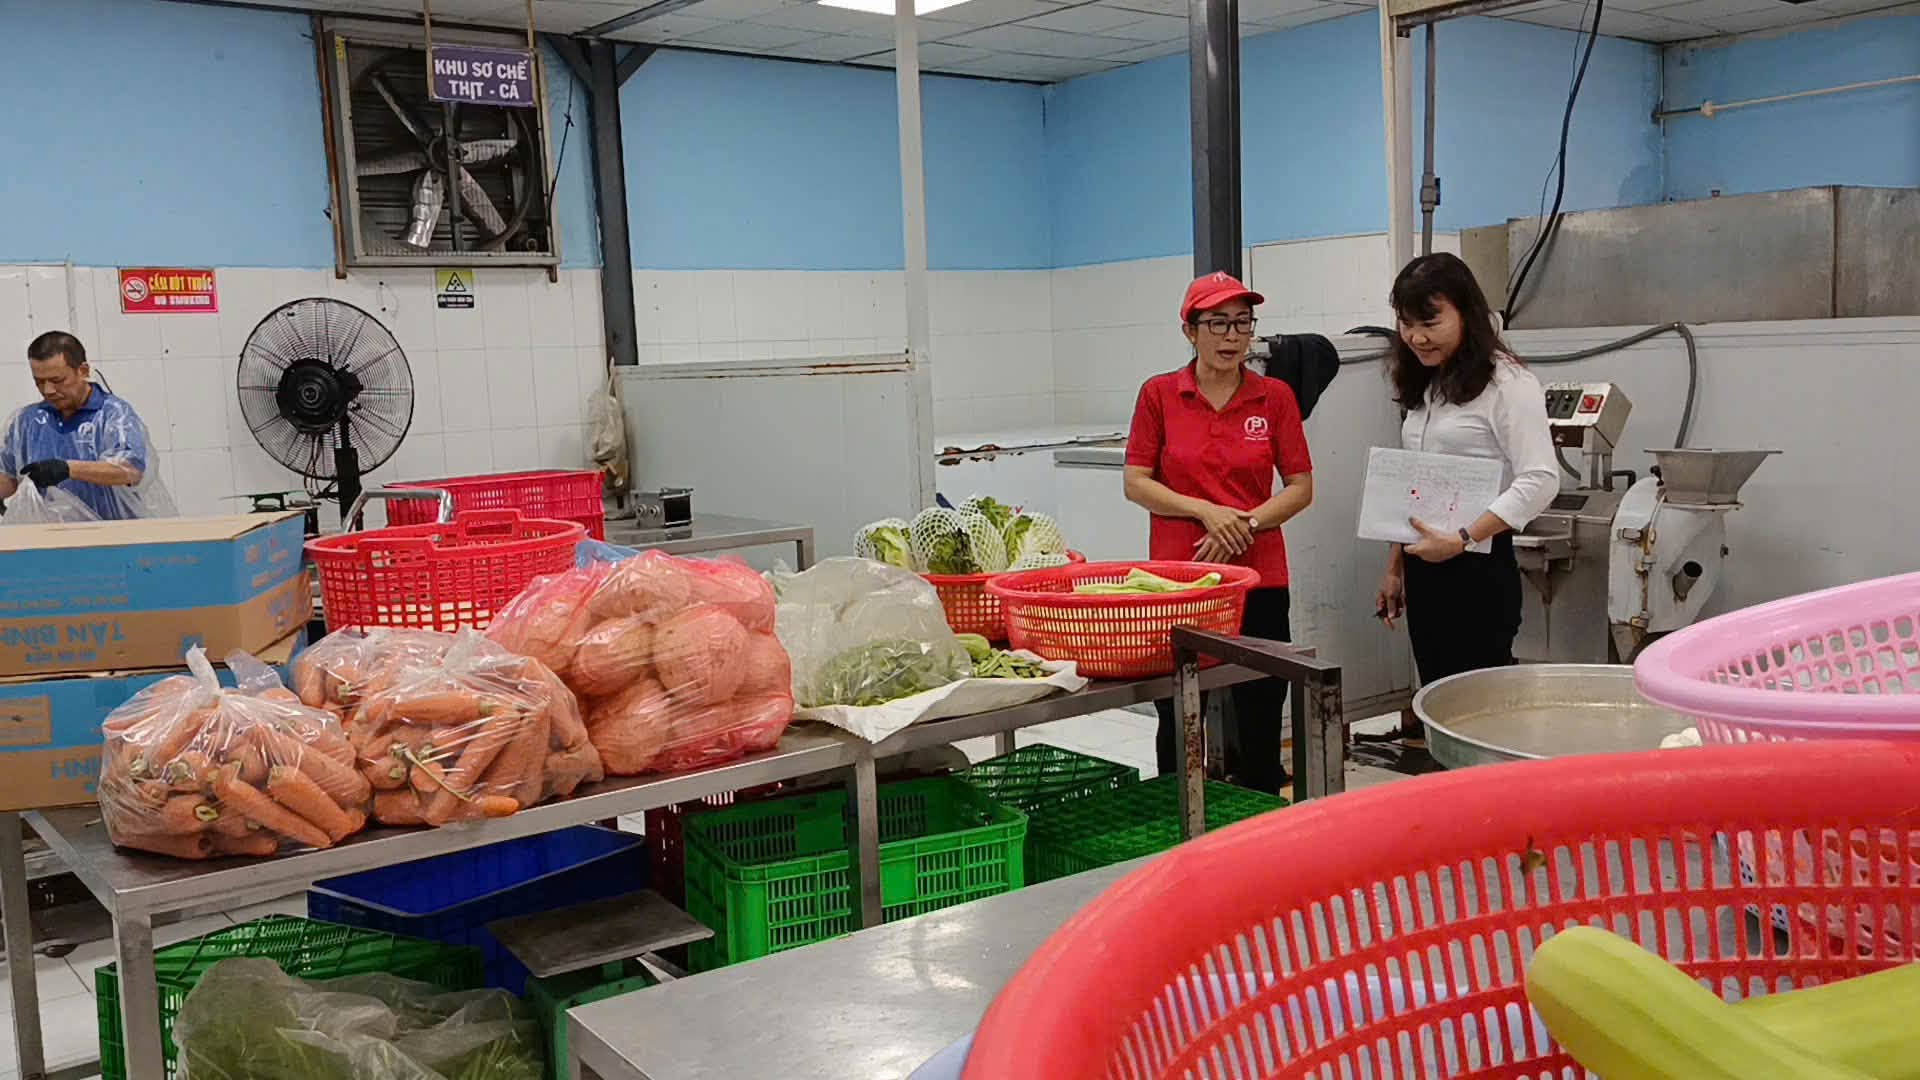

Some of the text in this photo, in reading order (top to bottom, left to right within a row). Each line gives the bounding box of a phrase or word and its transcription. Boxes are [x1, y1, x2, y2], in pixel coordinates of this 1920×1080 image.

[434, 58, 528, 80] KHU SƠ CHẾ
[448, 79, 484, 100] THỊT
[499, 80, 520, 99] CÁ
[67, 623, 125, 649] TÂN
